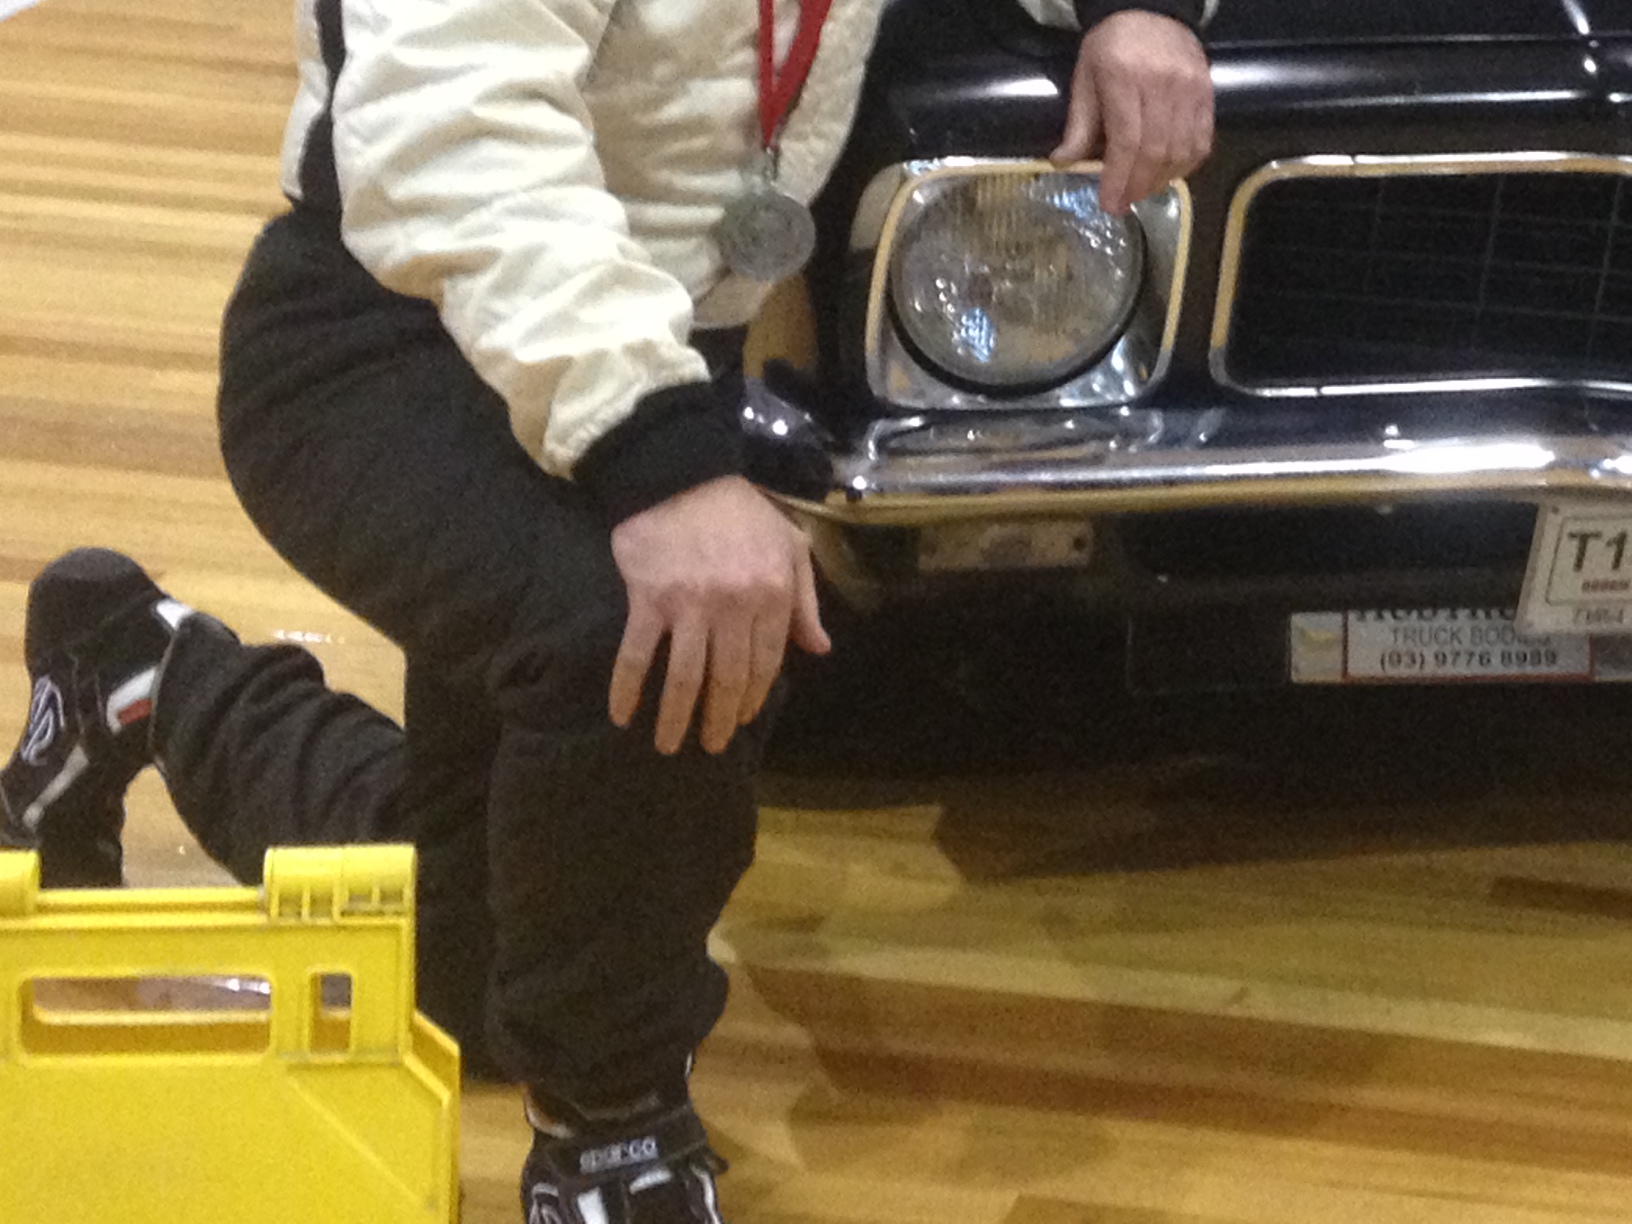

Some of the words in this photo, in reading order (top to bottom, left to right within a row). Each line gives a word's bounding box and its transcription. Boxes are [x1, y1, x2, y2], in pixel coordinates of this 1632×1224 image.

[1391, 626, 1463, 647] TRUCK
[1380, 650, 1426, 672] (03)
[1433, 649, 1493, 669] 9776
